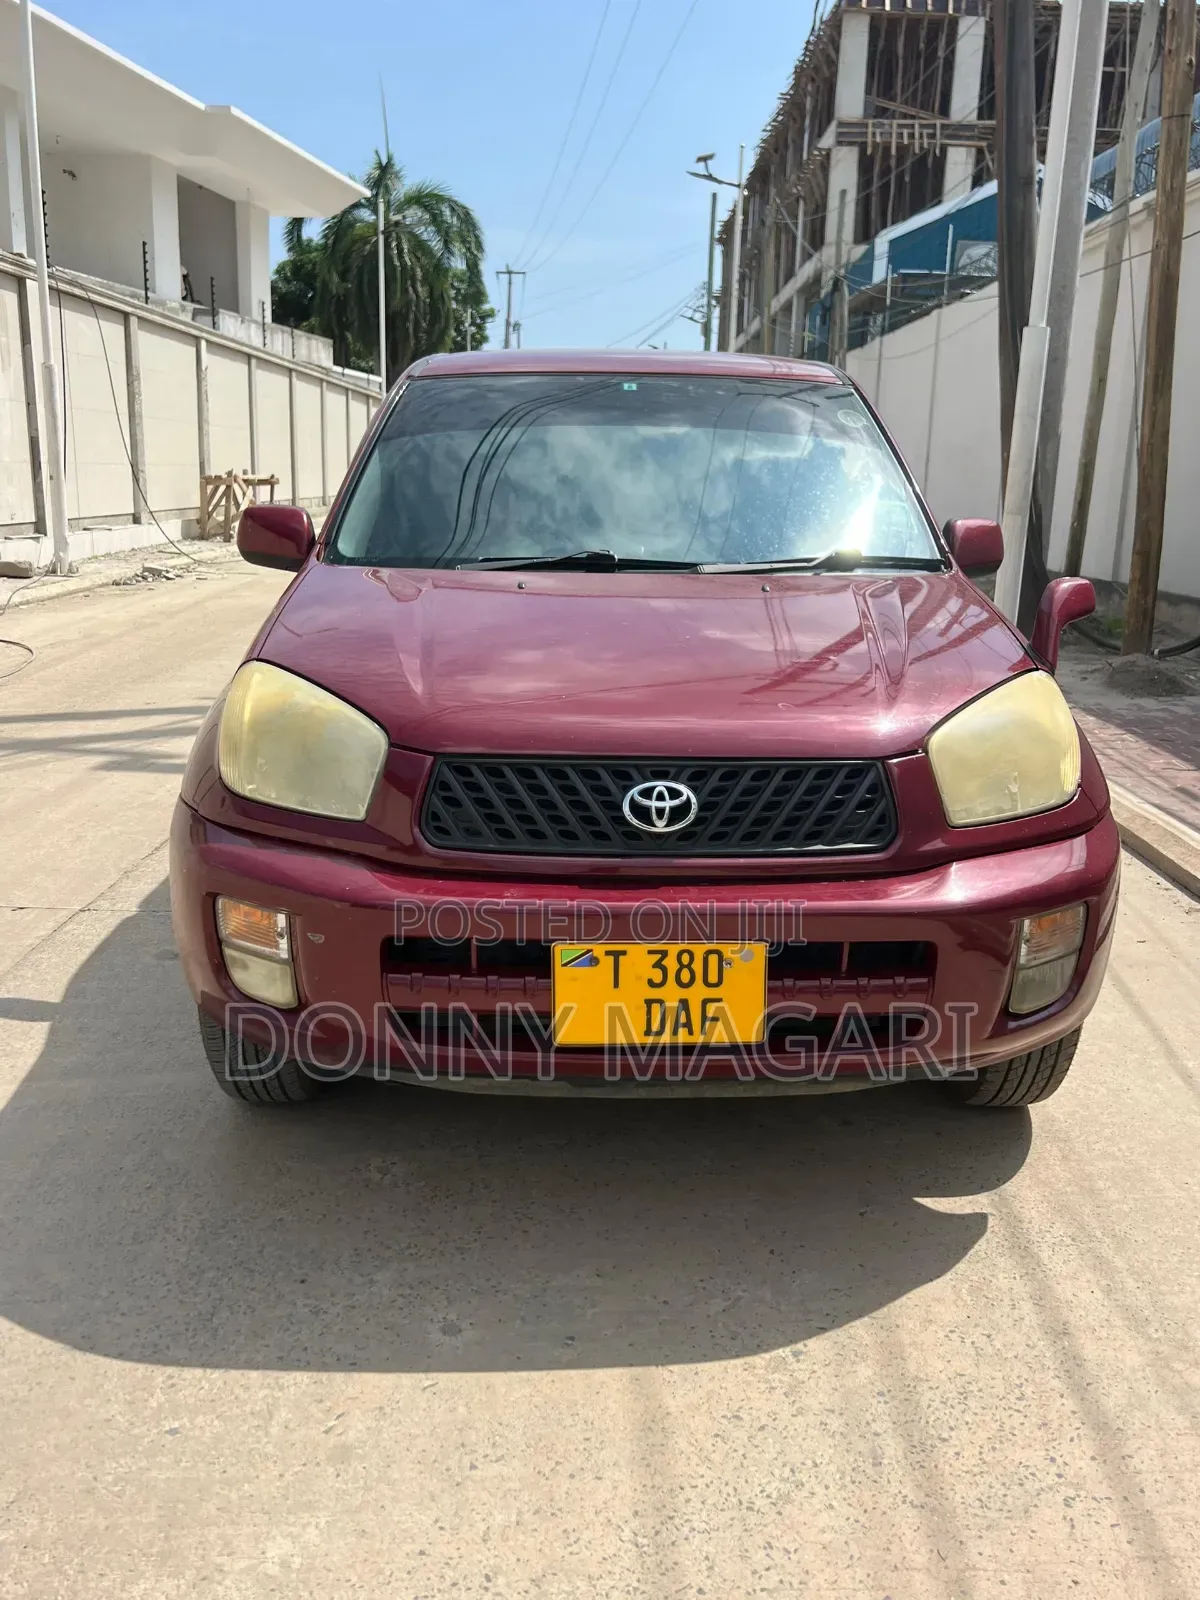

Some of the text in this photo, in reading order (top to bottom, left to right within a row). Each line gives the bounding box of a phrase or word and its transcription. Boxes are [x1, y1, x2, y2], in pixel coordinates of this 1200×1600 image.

[604, 949, 724, 989] T 380
[644, 998, 723, 1037] DAF
